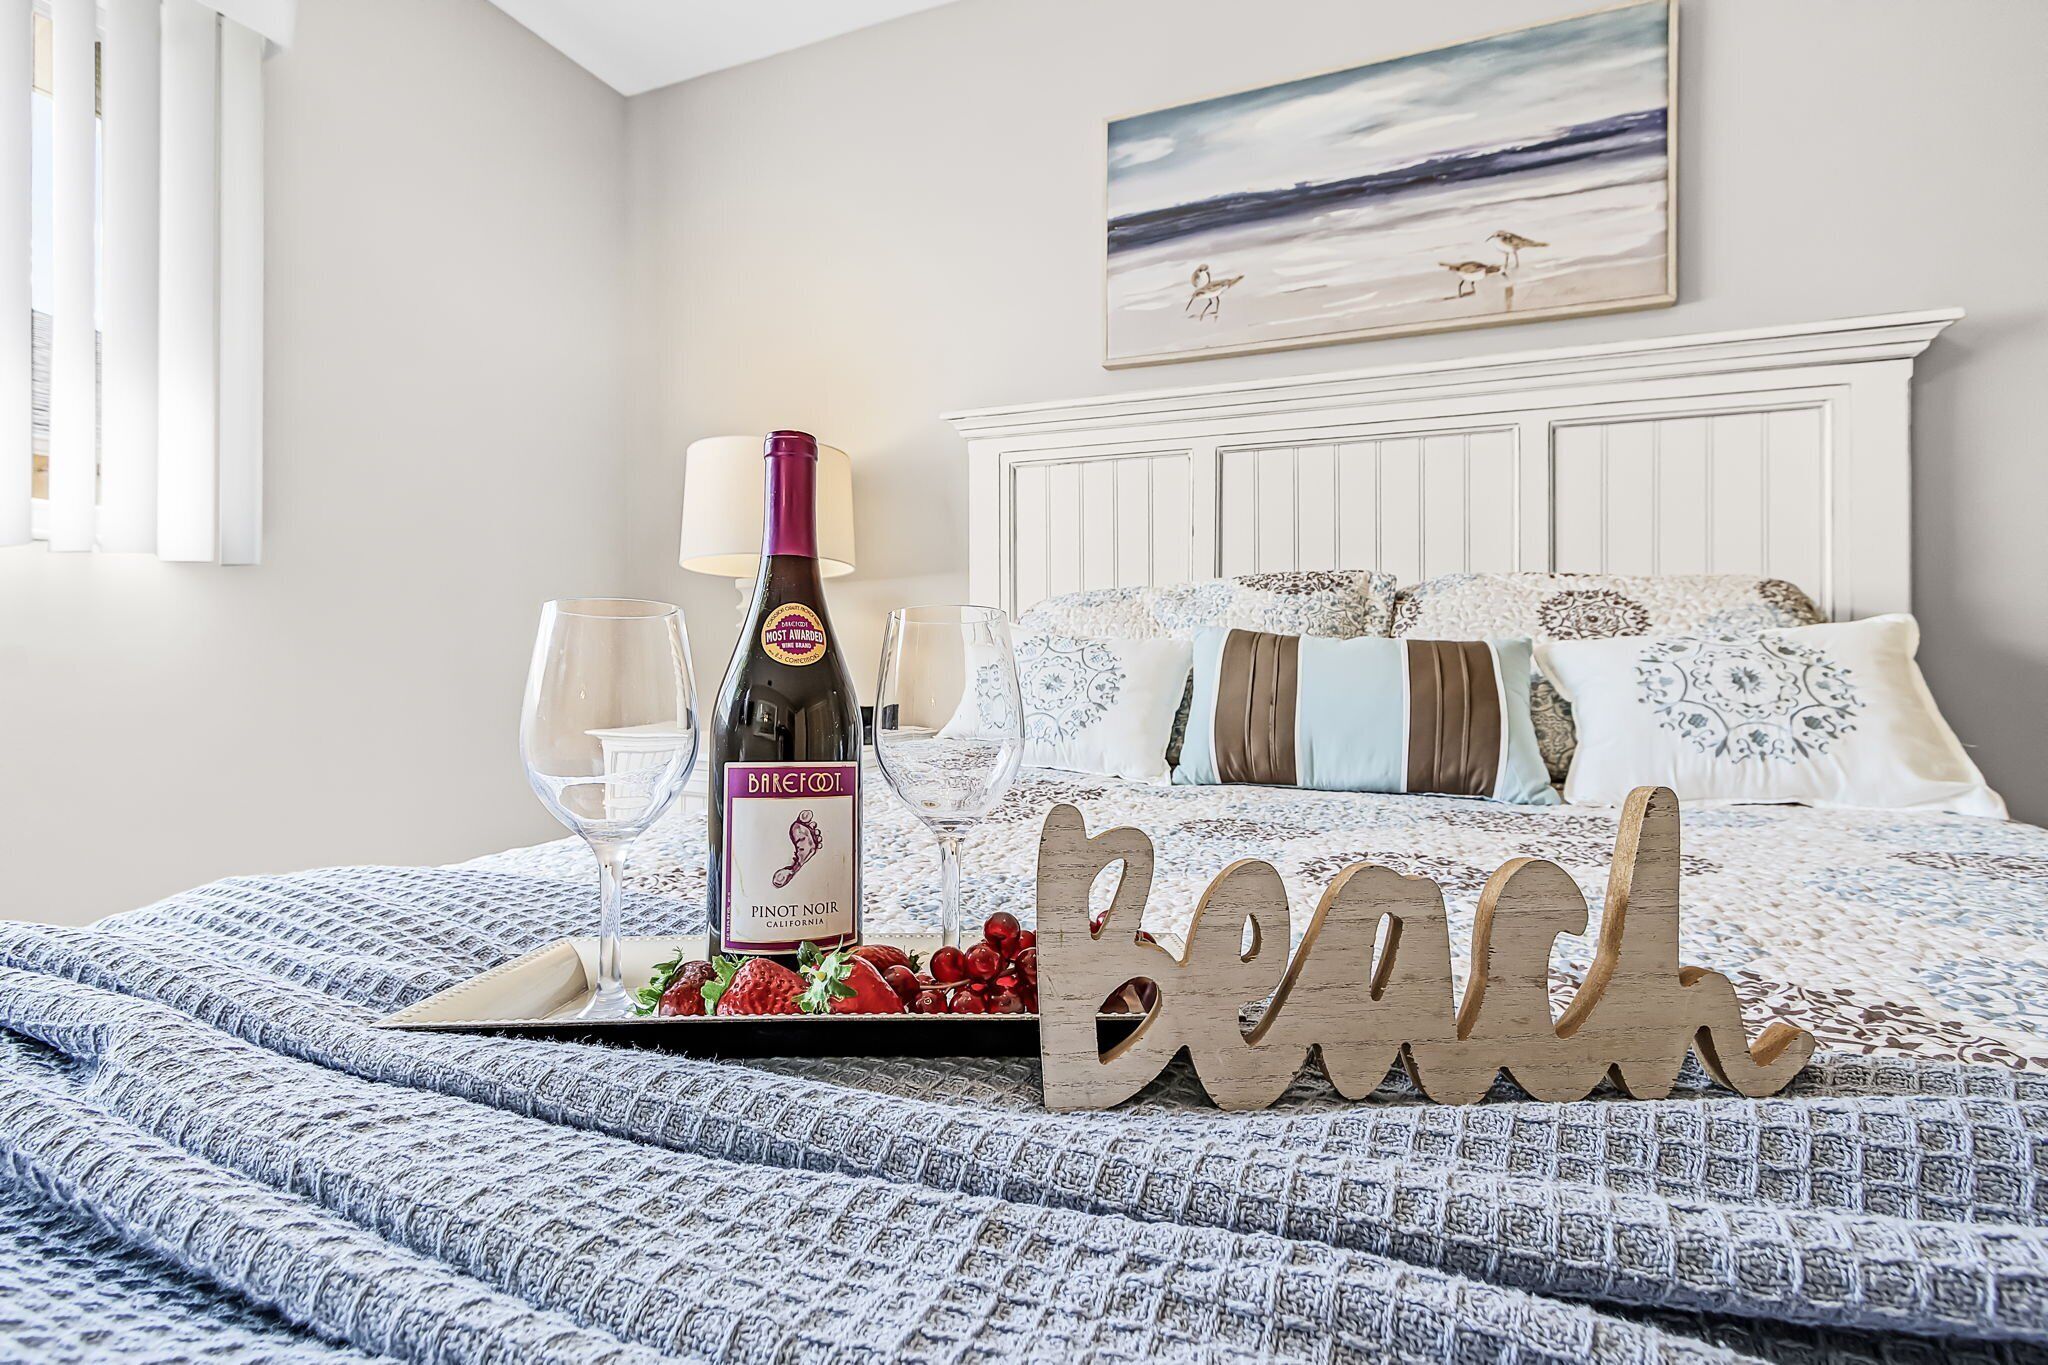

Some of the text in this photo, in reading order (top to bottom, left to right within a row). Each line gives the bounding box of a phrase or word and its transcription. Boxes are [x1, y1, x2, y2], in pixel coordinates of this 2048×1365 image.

[766, 629, 823, 643] MOST AWARDED
[751, 901, 839, 918] PINOT NOIR
[766, 918, 824, 928] CALIFORNIA
[1036, 786, 1816, 1111] Beach
